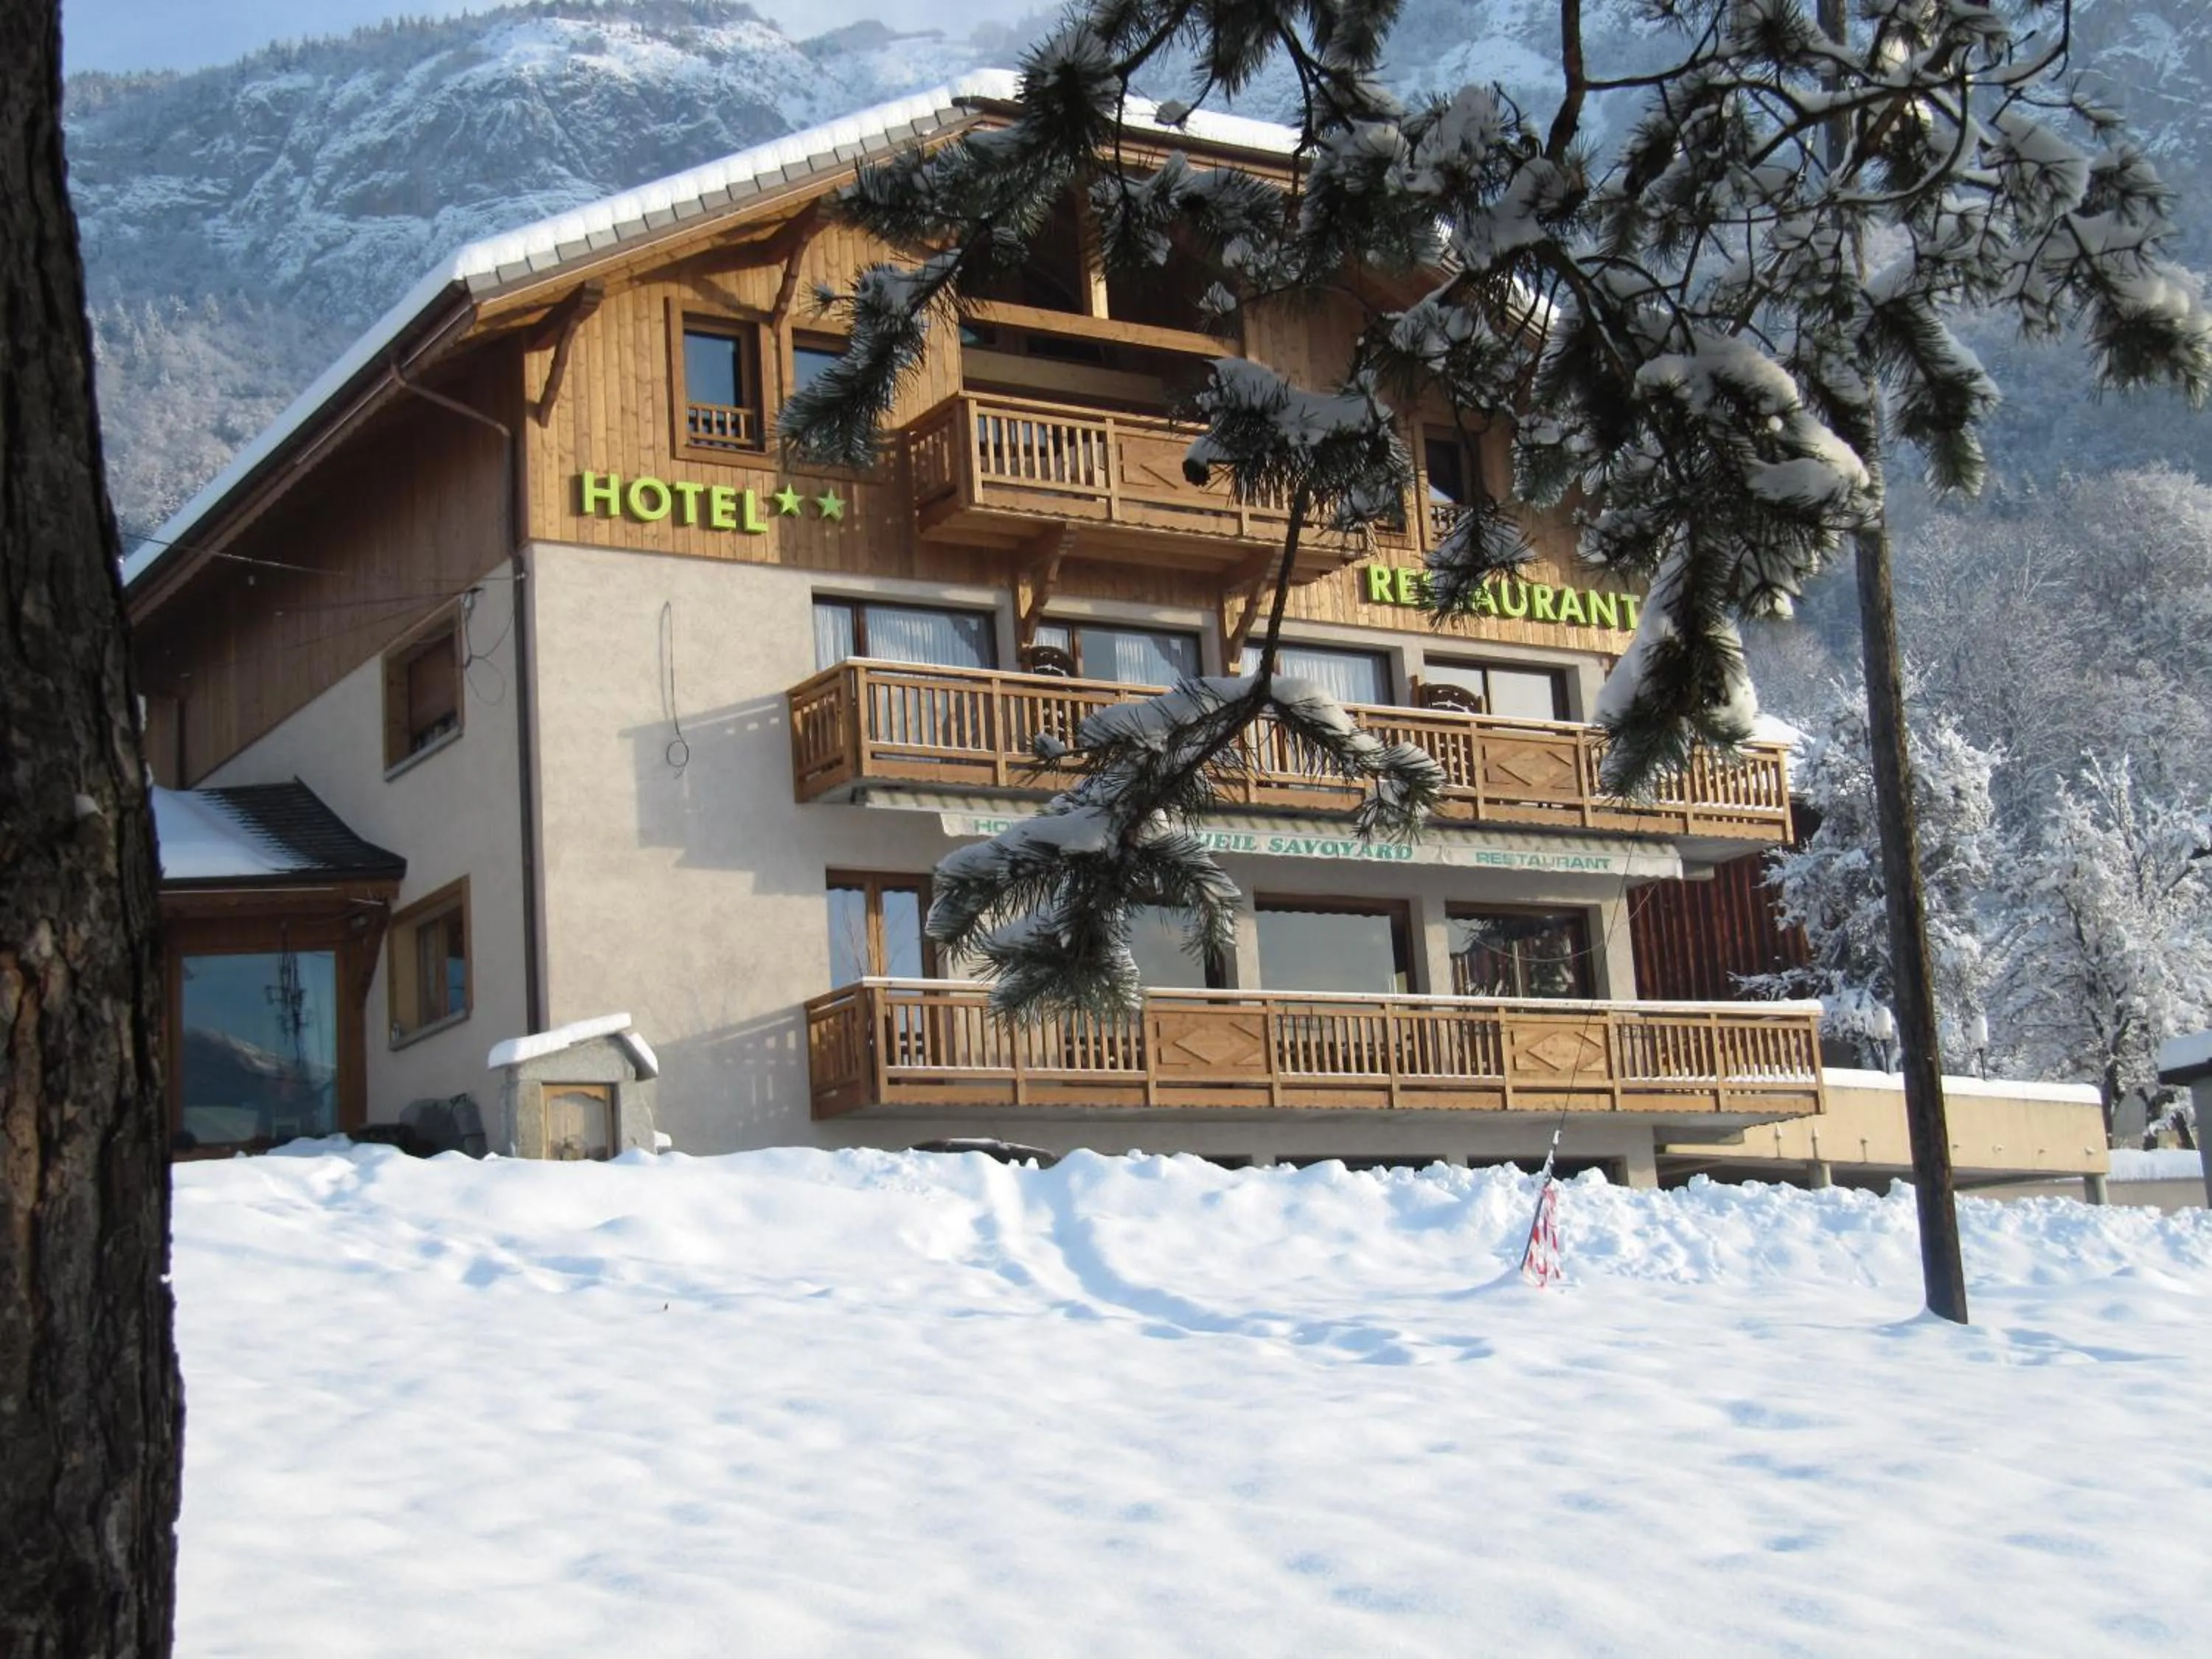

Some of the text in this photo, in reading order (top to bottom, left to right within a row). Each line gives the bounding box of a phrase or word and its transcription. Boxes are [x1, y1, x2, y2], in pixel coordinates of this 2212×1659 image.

[582, 470, 768, 533] HOTEL
[1366, 563, 1641, 630] REAURANT
[1267, 837, 1413, 860] SAVOYARD
[1475, 851, 1613, 870] RESTAURANT
